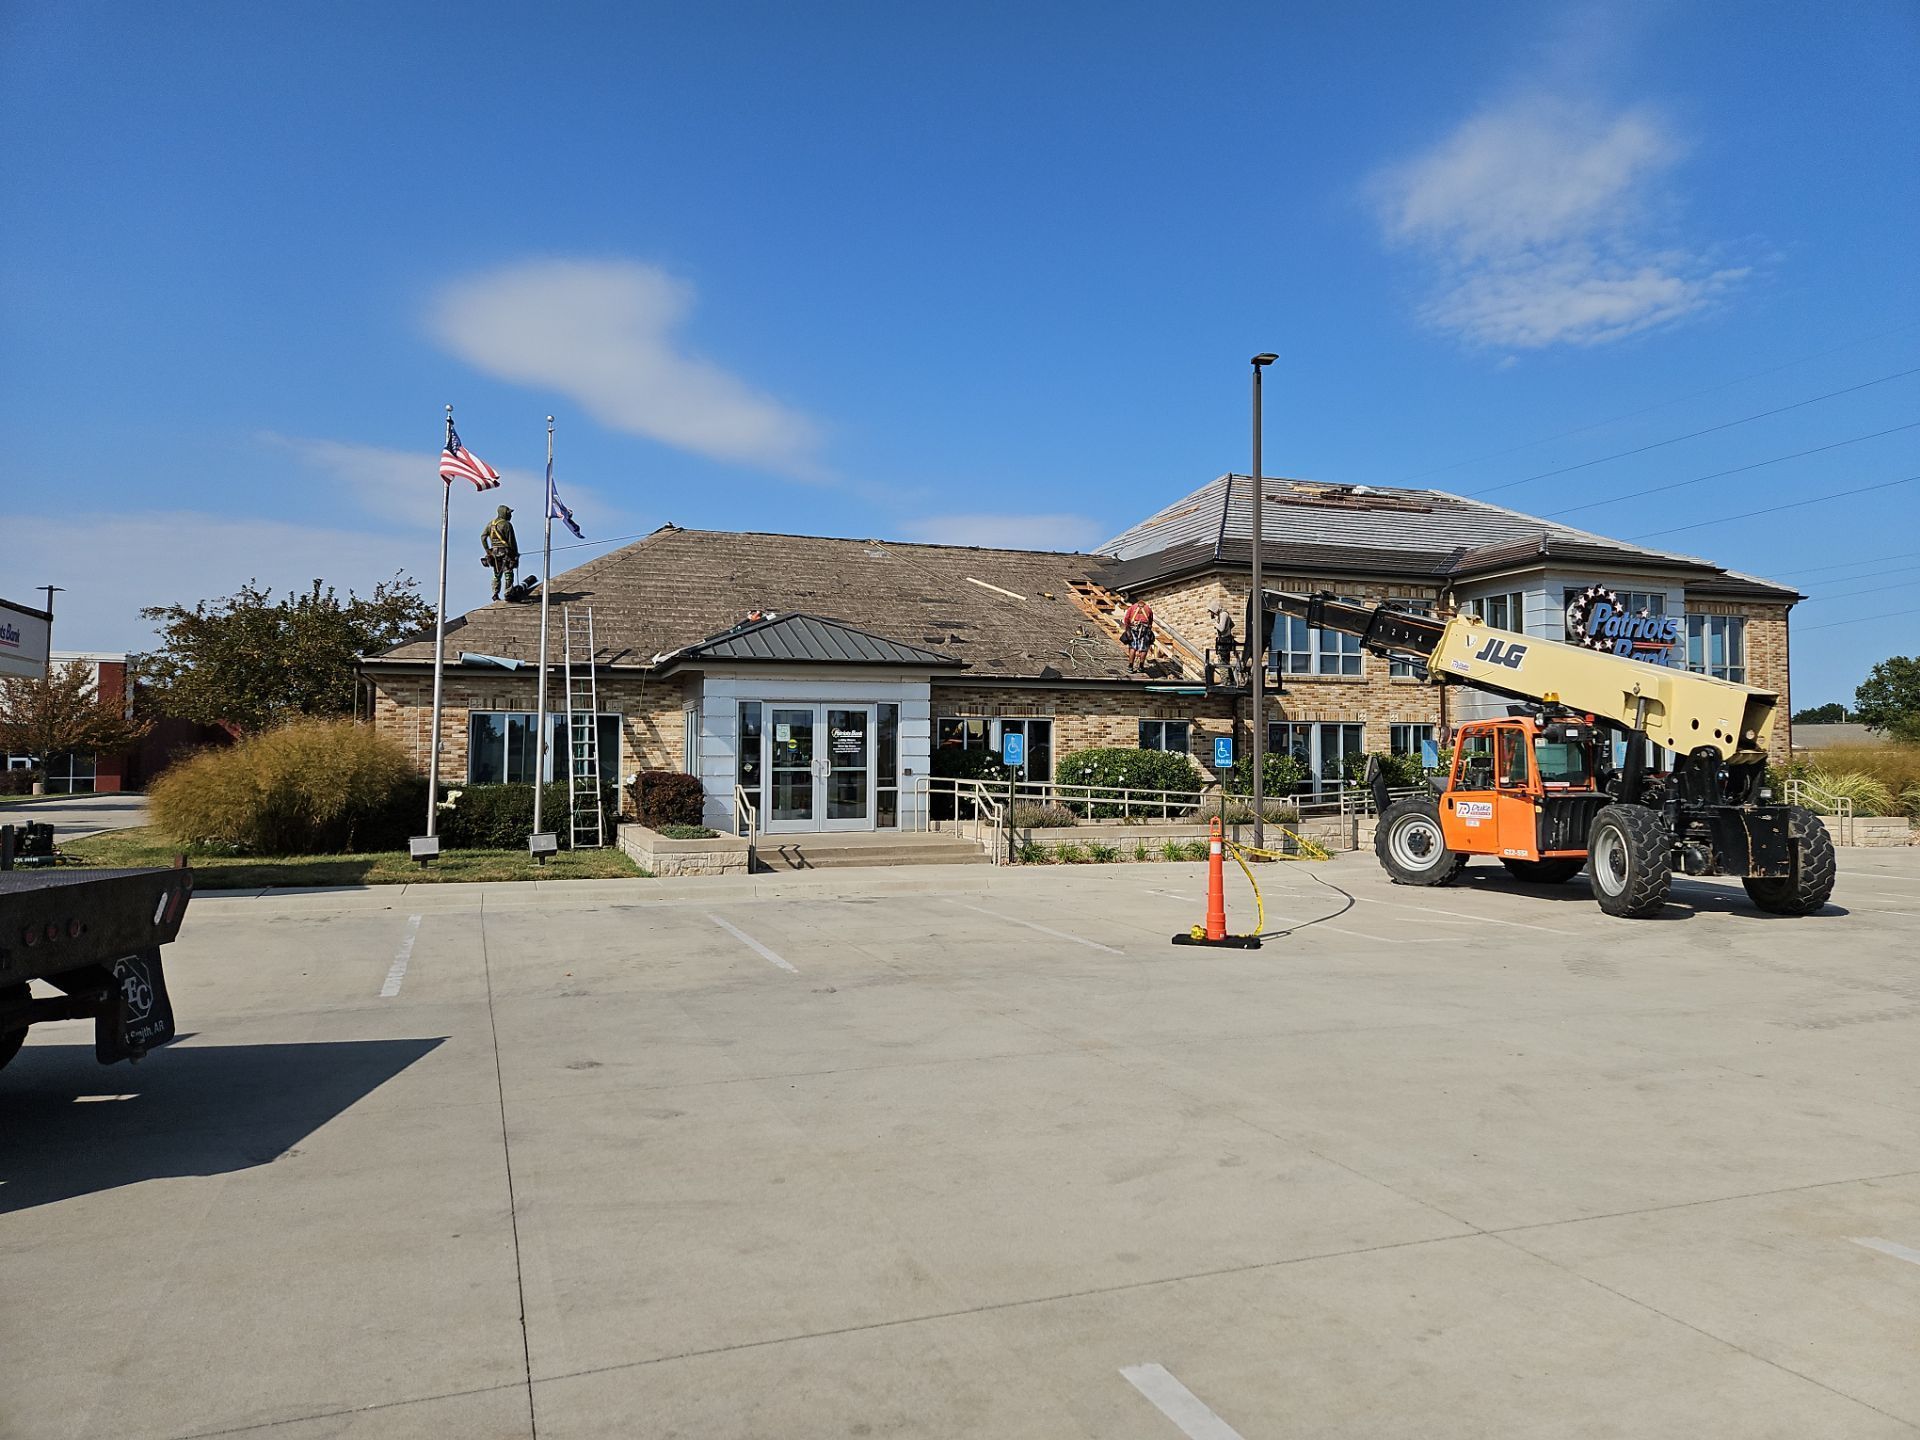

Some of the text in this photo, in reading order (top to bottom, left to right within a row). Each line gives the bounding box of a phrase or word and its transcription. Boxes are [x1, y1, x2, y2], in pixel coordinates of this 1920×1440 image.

[1588, 602, 1678, 640] Patriots
[6, 623, 20, 643] Bank
[1391, 628, 1396, 636] 2
[1404, 631, 1409, 639] 3
[1475, 638, 1527, 670] JLG
[153, 1019, 165, 1034] AR
